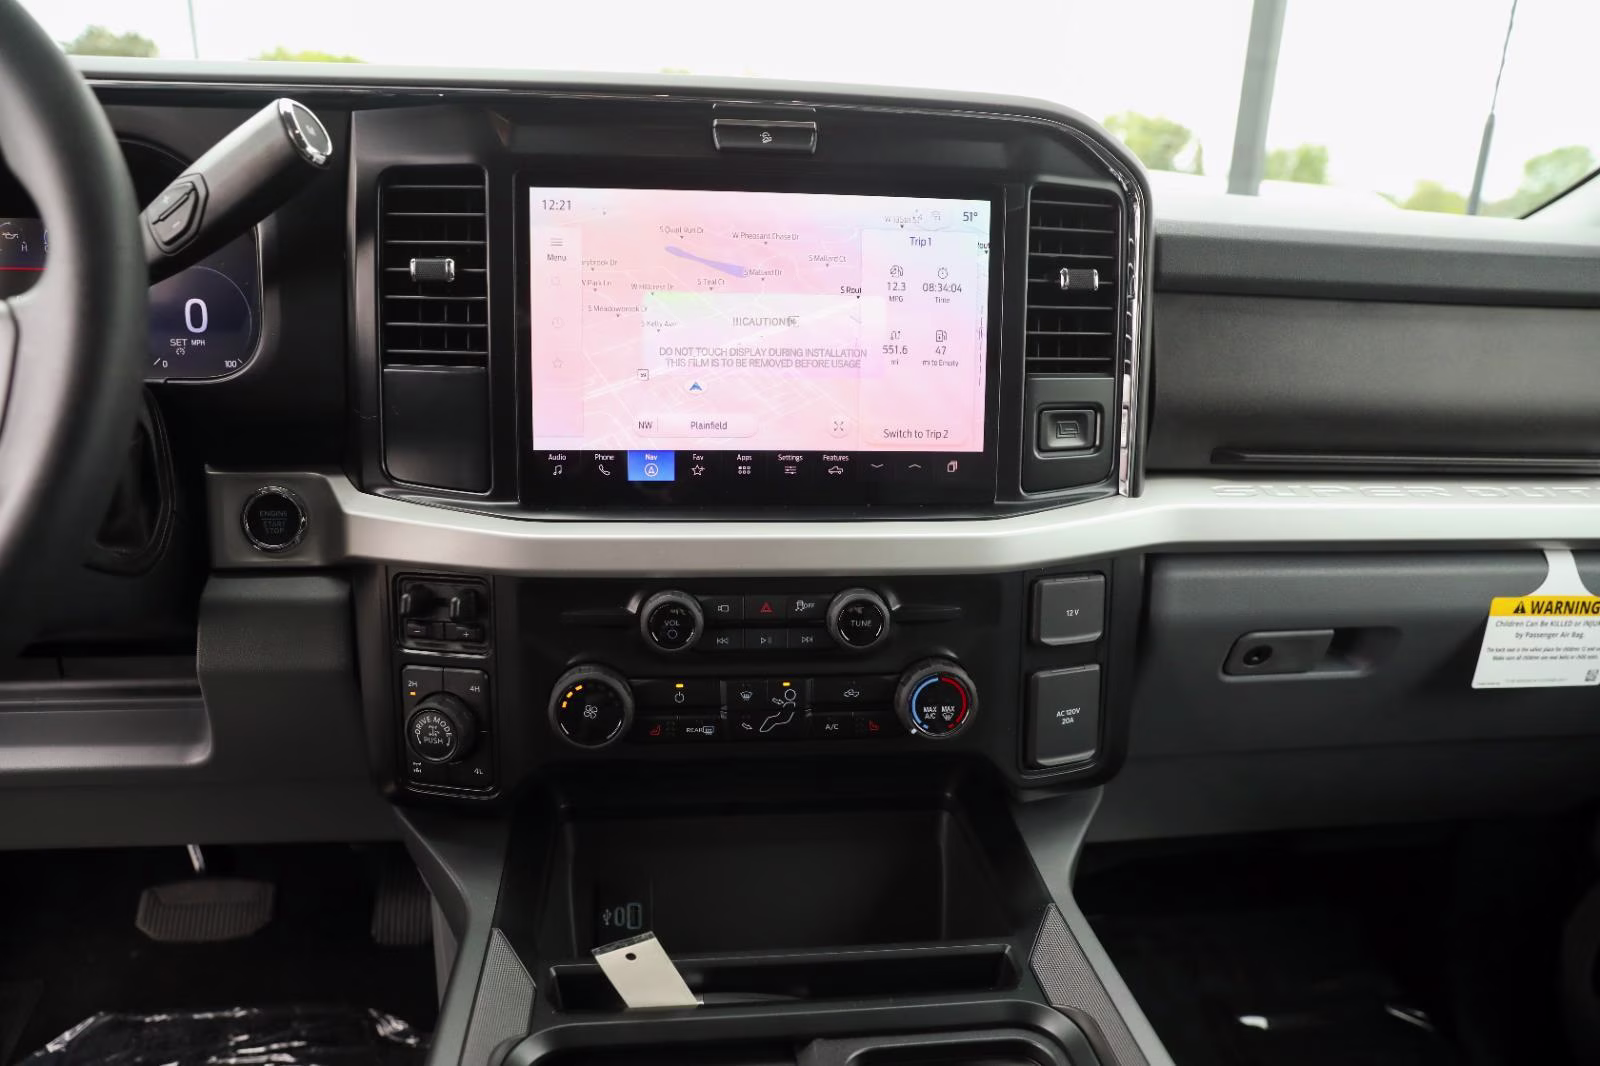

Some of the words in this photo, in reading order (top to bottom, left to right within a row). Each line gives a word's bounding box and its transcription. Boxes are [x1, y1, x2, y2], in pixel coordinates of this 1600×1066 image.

[542, 200, 572, 211] 12:21
[910, 236, 926, 248] Trip
[547, 254, 567, 262] Menu
[888, 282, 906, 292] 12.3
[922, 283, 962, 292] 08:34:04
[184, 298, 208, 333] 0
[170, 338, 188, 346] SET
[191, 338, 206, 346] MPH
[659, 348, 672, 356] DO
[674, 348, 693, 356] NOT
[696, 348, 727, 356] TOUCH
[730, 348, 766, 356] DISPLAY
[768, 348, 803, 356] DURING
[806, 348, 868, 356] INSTALLATION
[882, 344, 908, 354] 551.6
[936, 346, 946, 355] 47
[224, 360, 237, 368] 100
[666, 358, 686, 368] THIS
[688, 358, 710, 368] FILM
[711, 358, 720, 368] IS
[721, 358, 734, 368] TO
[736, 358, 748, 368] BE
[749, 358, 793, 368] REMOVED
[795, 358, 830, 368] BEFORE
[831, 358, 861, 368] USAGE
[638, 421, 652, 430] NW
[690, 421, 728, 430] Plainfield
[883, 429, 912, 440] Switch
[914, 429, 924, 440] to
[926, 429, 942, 440] Trip
[736, 454, 752, 462] Apps
[778, 454, 803, 462] Settings
[1211, 485, 1453, 497] SUPER
[1462, 485, 1600, 497] DUT
[1530, 600, 1600, 614] WARNING
[1066, 708, 1080, 716] 120V
[414, 716, 432, 736] DRIVE
[432, 716, 452, 737] MODE
[824, 722, 839, 731] A/C
[424, 736, 444, 744] PUSH
